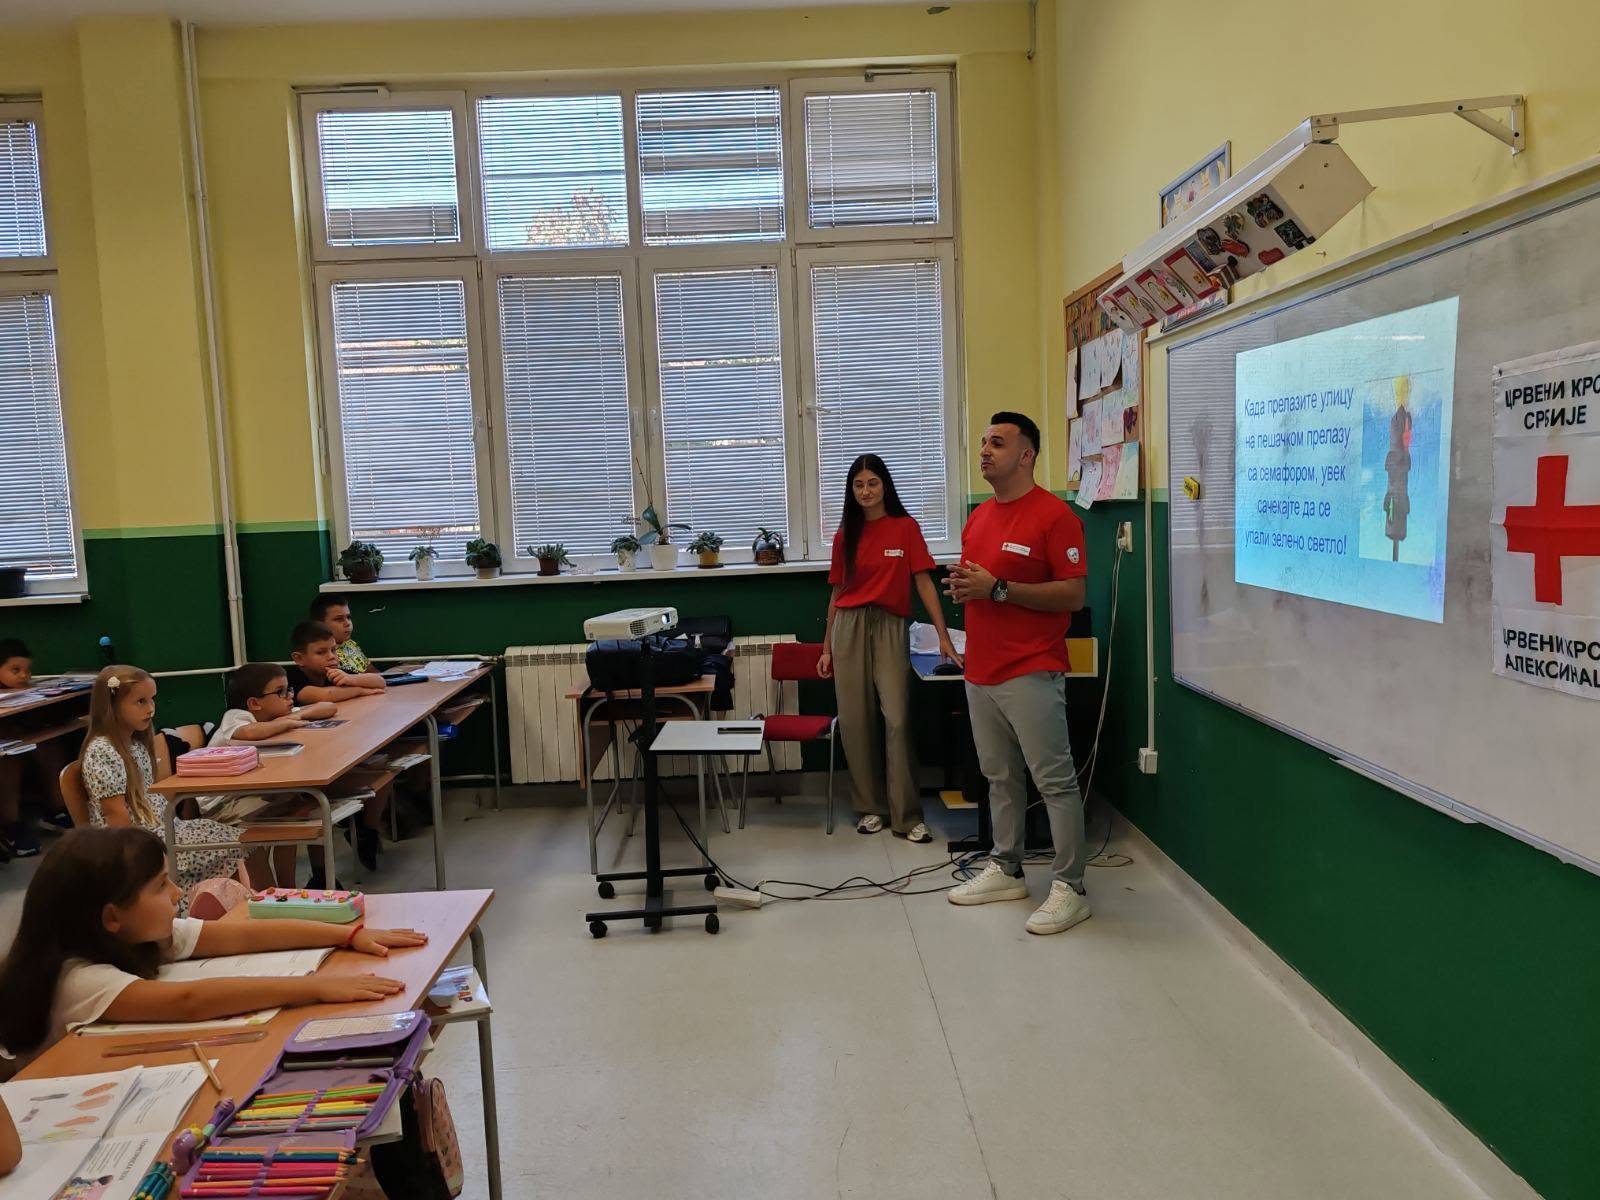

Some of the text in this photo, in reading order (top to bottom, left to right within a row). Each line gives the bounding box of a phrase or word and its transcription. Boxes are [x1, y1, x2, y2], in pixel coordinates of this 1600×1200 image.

[1244, 387, 1354, 419] Када прелазите улицу
[1505, 381, 1565, 410] ЦРВЕНИ
[1524, 404, 1587, 430] СРБИЈЕ
[1245, 426, 1351, 450] на пешачком прелазу
[1247, 462, 1346, 487] са семафором, увек
[1257, 496, 1331, 520] сачекајте да се
[1245, 529, 1347, 555] упали зелено светло!
